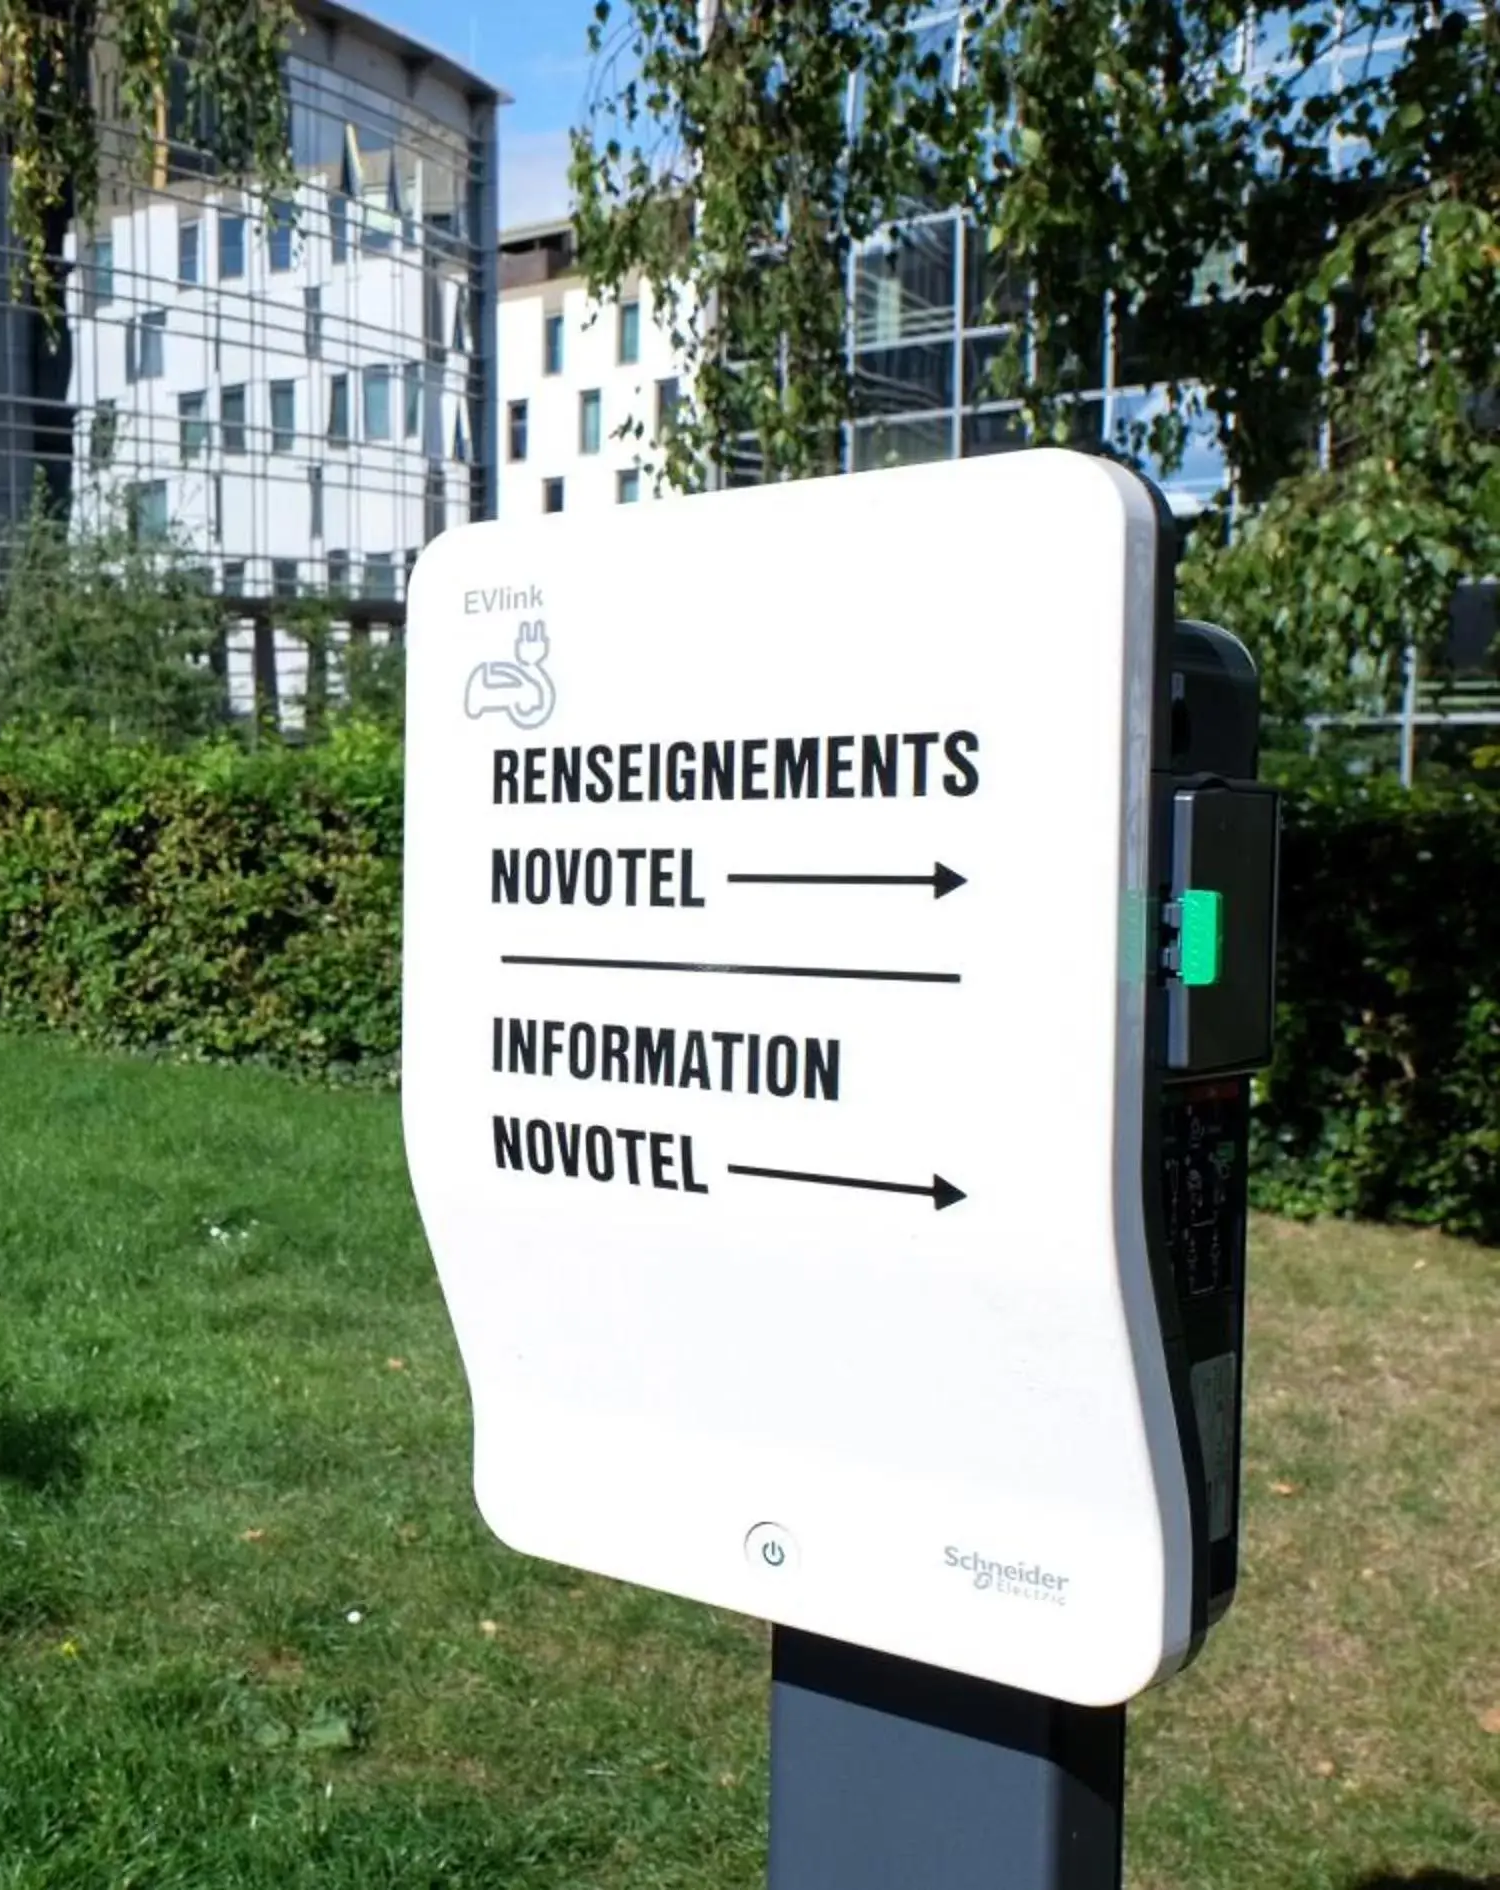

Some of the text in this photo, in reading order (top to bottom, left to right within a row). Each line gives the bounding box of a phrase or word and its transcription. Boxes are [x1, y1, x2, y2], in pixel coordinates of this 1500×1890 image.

[464, 583, 544, 615] EVlink
[492, 730, 979, 805] RENSEIGNEMENTS
[491, 847, 705, 908] NOVOTEL
[493, 1017, 840, 1101] INFORMATION
[493, 1115, 709, 1194] NOVOTEL
[943, 1545, 1070, 1591] Schneider
